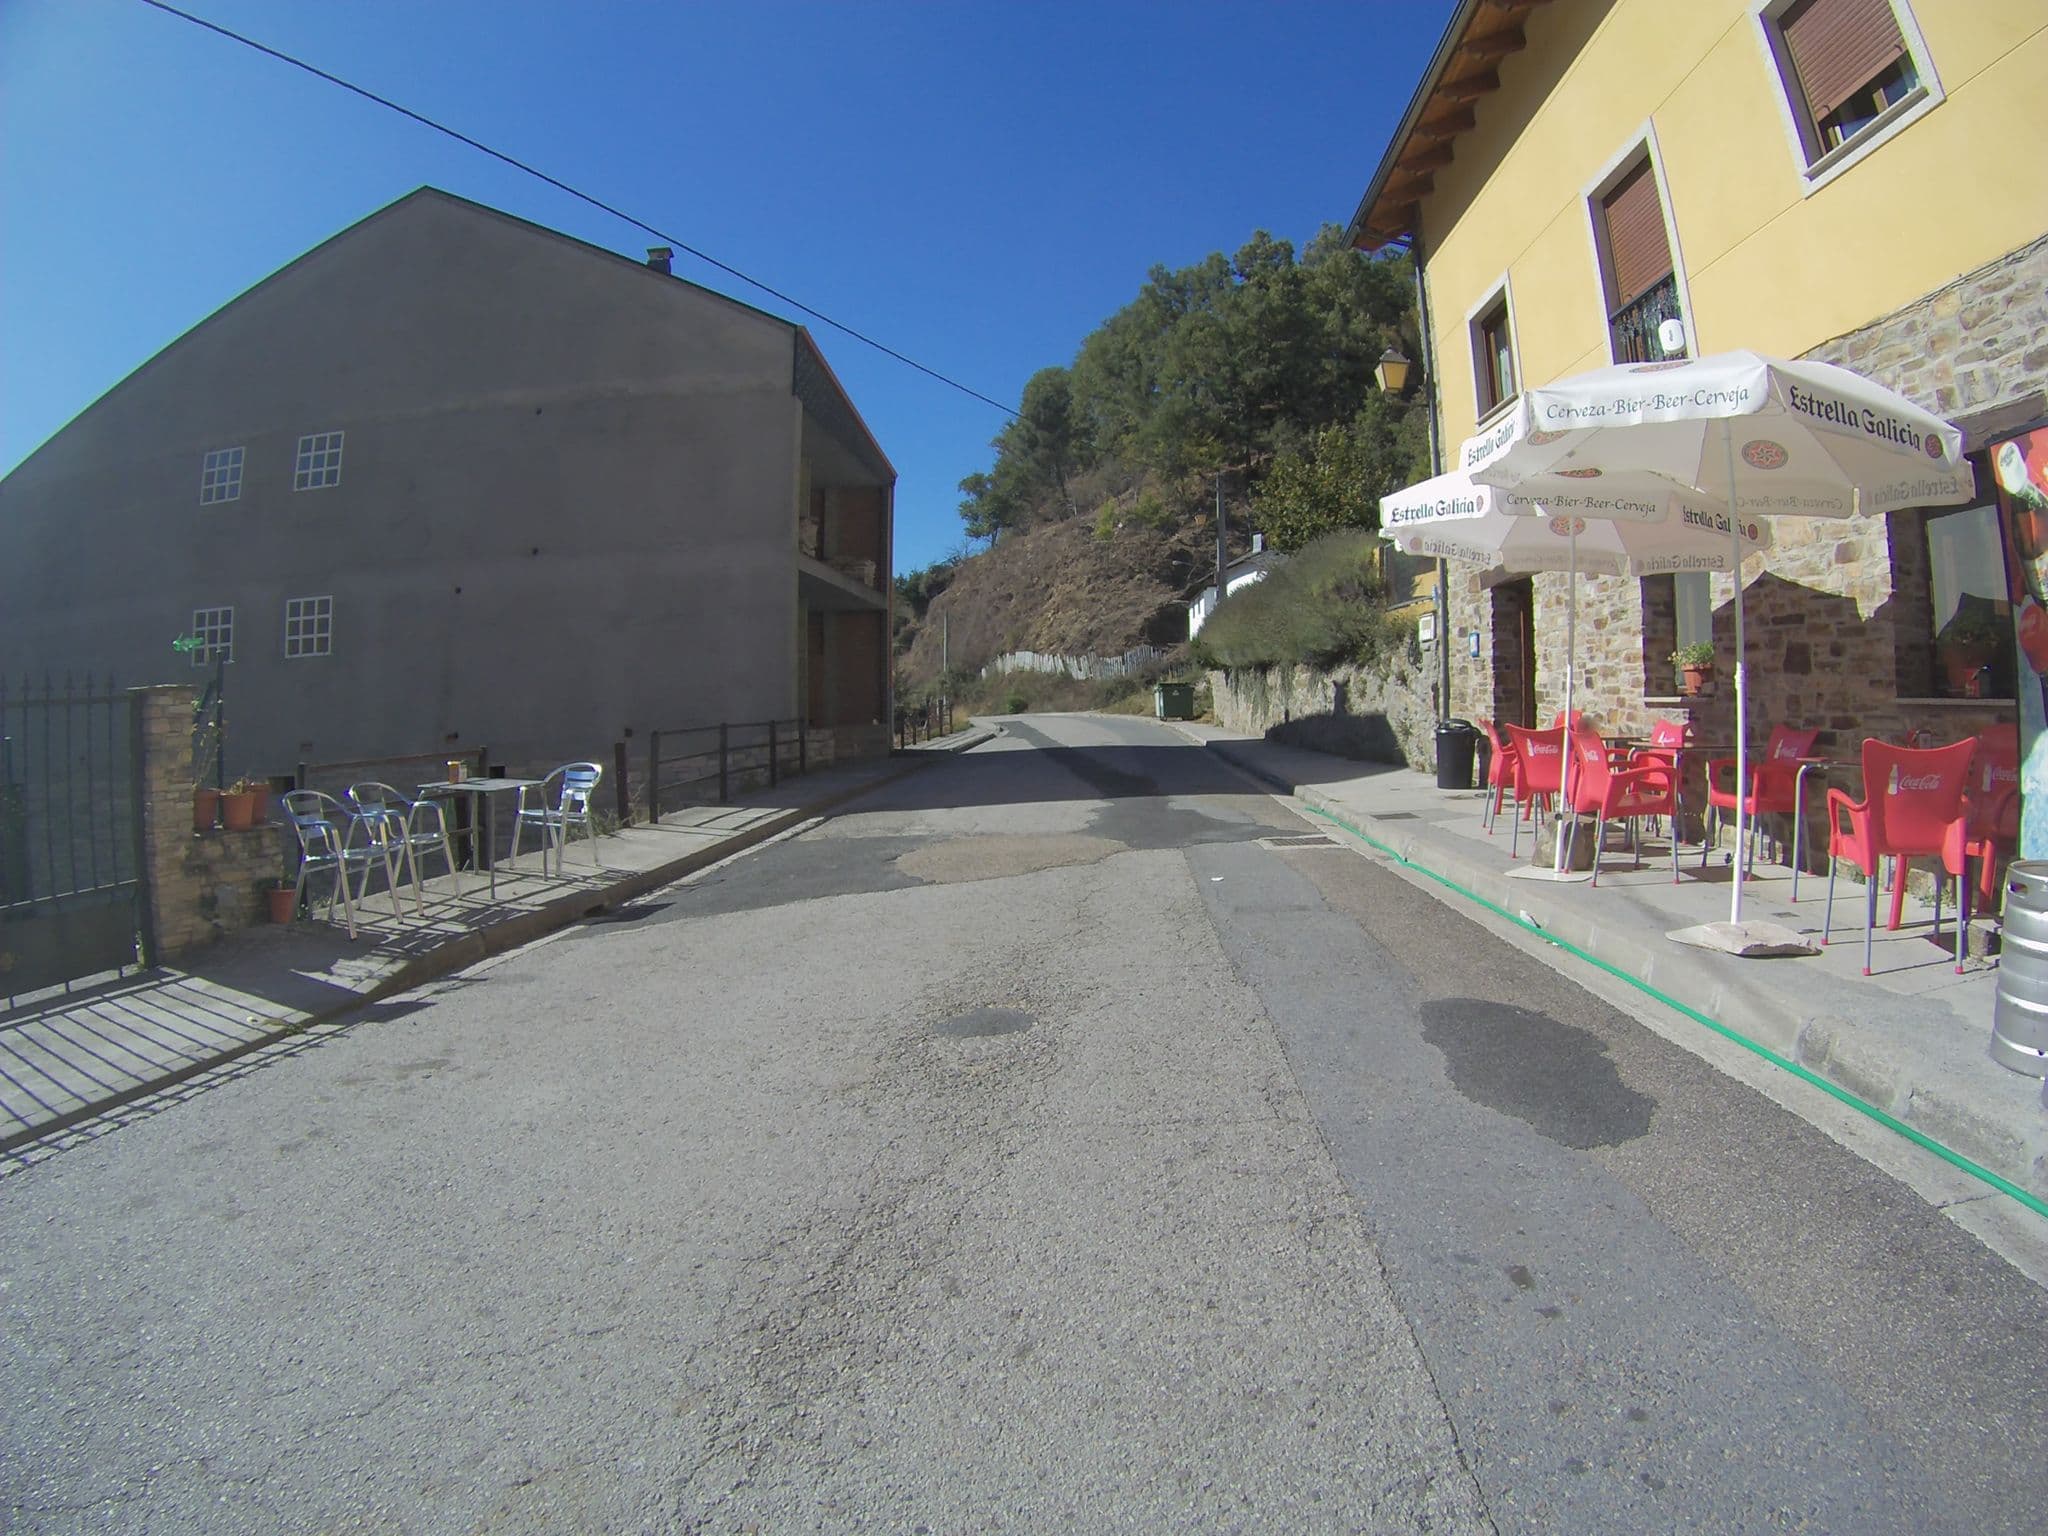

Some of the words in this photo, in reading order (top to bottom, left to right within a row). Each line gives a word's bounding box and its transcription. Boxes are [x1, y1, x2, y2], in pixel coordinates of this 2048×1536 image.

[1546, 385, 1750, 419] Cerveza-Bier-Beer-Cerveja
[1789, 385, 1860, 428] Estrella
[1861, 408, 1921, 452] Galicia
[1391, 503, 1434, 523] Estrella
[1435, 496, 1474, 517] Galicia
